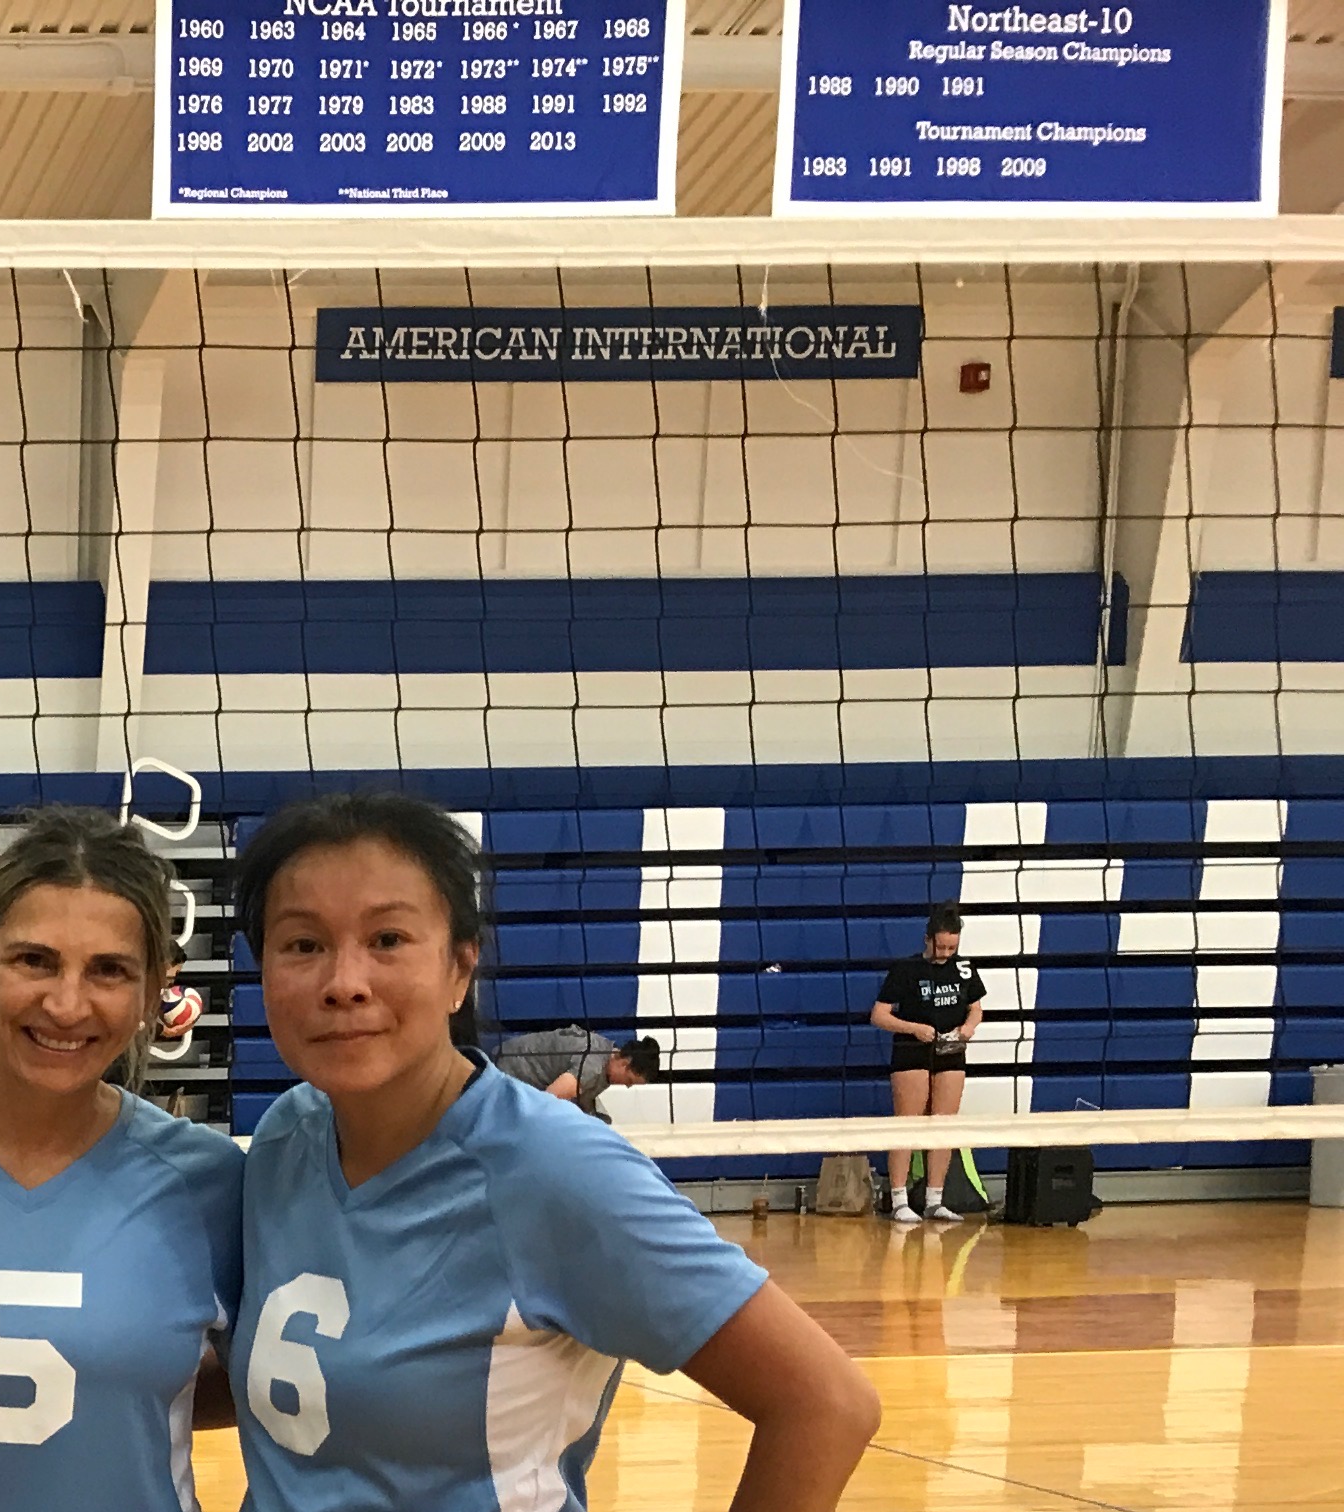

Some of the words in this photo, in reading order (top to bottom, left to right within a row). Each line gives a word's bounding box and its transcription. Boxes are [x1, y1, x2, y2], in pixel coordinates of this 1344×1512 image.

[284, 0, 378, 16] NCAA
[384, 0, 563, 17] Tournament
[180, 19, 224, 38] 1960
[250, 21, 294, 40] 1963
[321, 21, 366, 40] 1964
[392, 22, 436, 41] 1965
[534, 20, 578, 39] 1967
[604, 18, 649, 38] 1968
[947, 5, 1132, 34] Northeast-10
[909, 40, 986, 63] Regular
[990, 41, 1059, 61] Season
[1062, 41, 1171, 67] Champions
[179, 57, 222, 76] 1969
[249, 59, 293, 78] 1970
[809, 75, 852, 96] 1988
[875, 77, 919, 96] 1990
[942, 77, 984, 96] 1991
[178, 95, 222, 114] 1976
[248, 96, 293, 115] 1977
[319, 96, 363, 115] 1979
[390, 95, 434, 114] 1983
[461, 95, 506, 114] 1988
[532, 95, 574, 114] 1991
[603, 94, 647, 114] 1992
[178, 132, 222, 151] 1998
[248, 133, 293, 152] 2002
[320, 133, 365, 152] 2003
[386, 133, 433, 152] 2008
[459, 132, 505, 151] 2009
[530, 132, 575, 150] 2013
[916, 121, 1032, 141] Tournament
[1036, 122, 1146, 146] Champions
[803, 157, 846, 176] 1983
[870, 157, 911, 177] 1991
[937, 157, 981, 176] 1998
[1001, 157, 1046, 177] 2009
[230, 187, 288, 200] Champions
[392, 188, 419, 198] Third
[421, 188, 448, 198] Place
[341, 327, 562, 360] AMERICAN
[572, 326, 896, 360] INTERNATIONAL
[956, 961, 972, 979] 5
[934, 996, 958, 1007] SINS
[247, 1272, 350, 1456] 6
